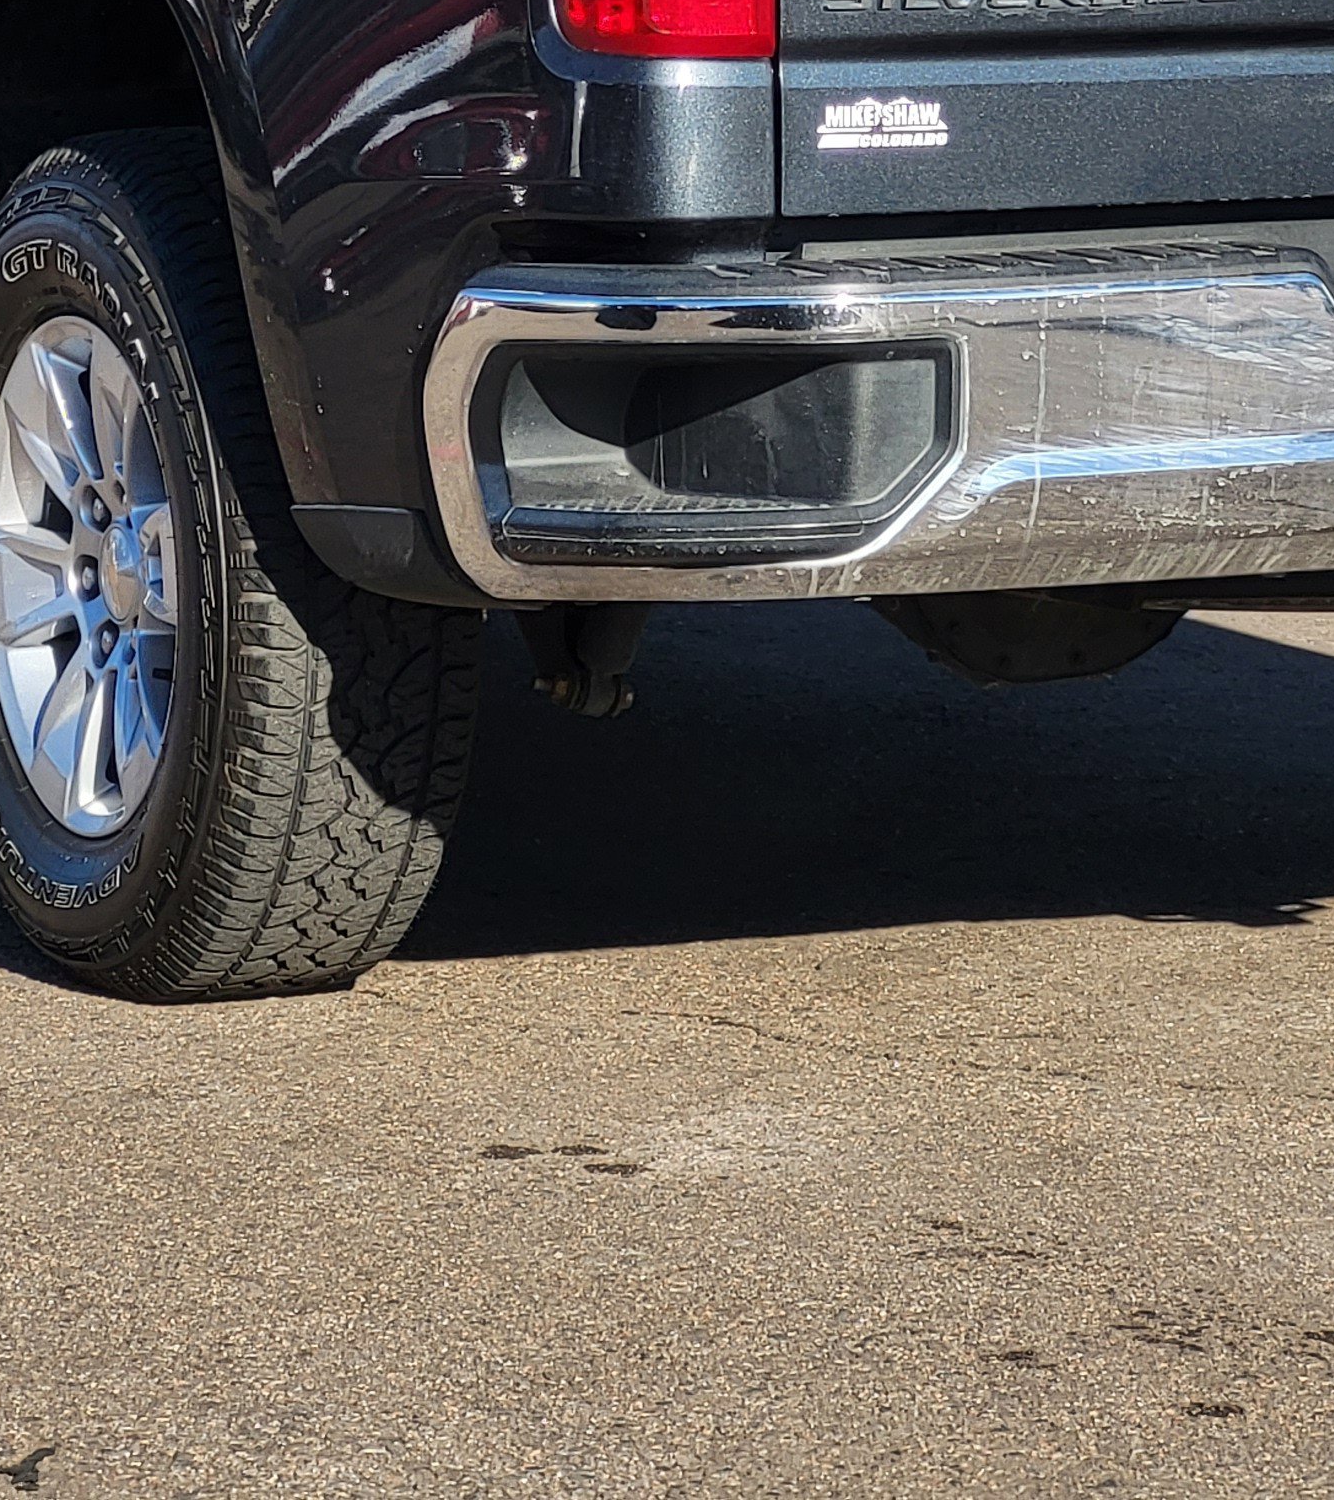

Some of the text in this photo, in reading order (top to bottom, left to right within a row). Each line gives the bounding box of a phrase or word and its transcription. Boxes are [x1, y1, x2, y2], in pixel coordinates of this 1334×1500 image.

[825, 103, 940, 128] MIKE SHAW
[858, 132, 948, 148] COLORADO
[2, 239, 52, 283] GT
